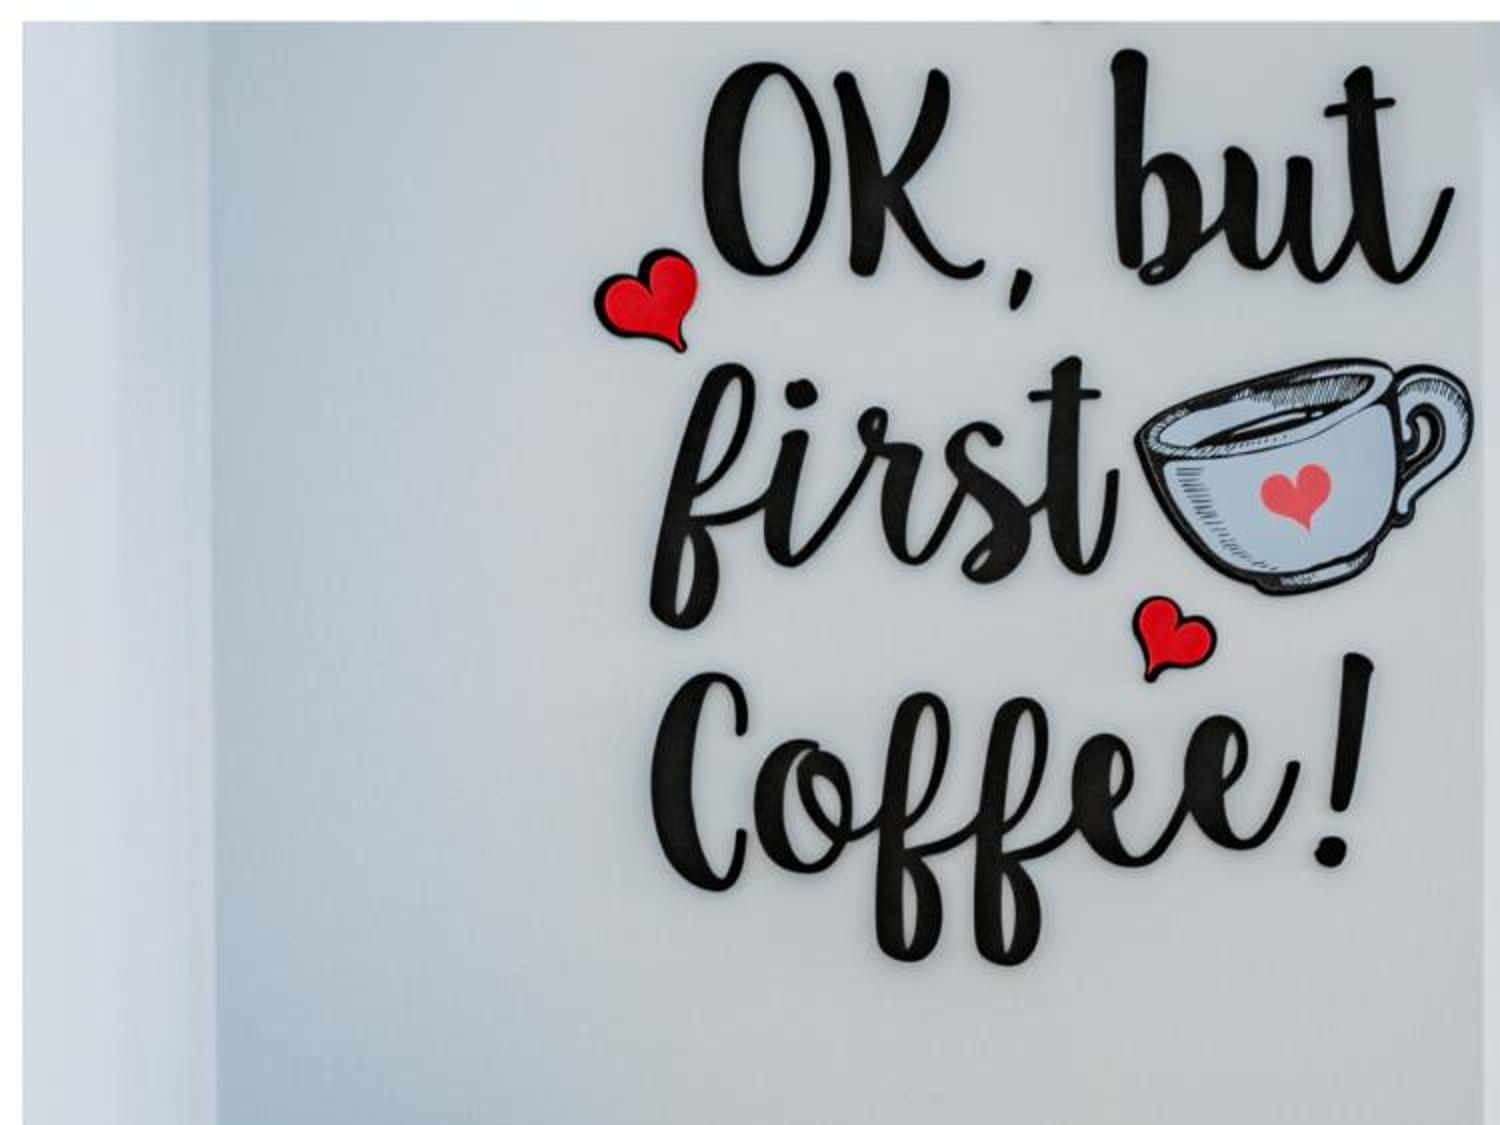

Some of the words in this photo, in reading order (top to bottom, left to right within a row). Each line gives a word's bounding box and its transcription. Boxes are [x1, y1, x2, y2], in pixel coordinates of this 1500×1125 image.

[1111, 48, 1456, 286] but
[648, 356, 1120, 631] first
[651, 652, 1375, 967] Coffee!
